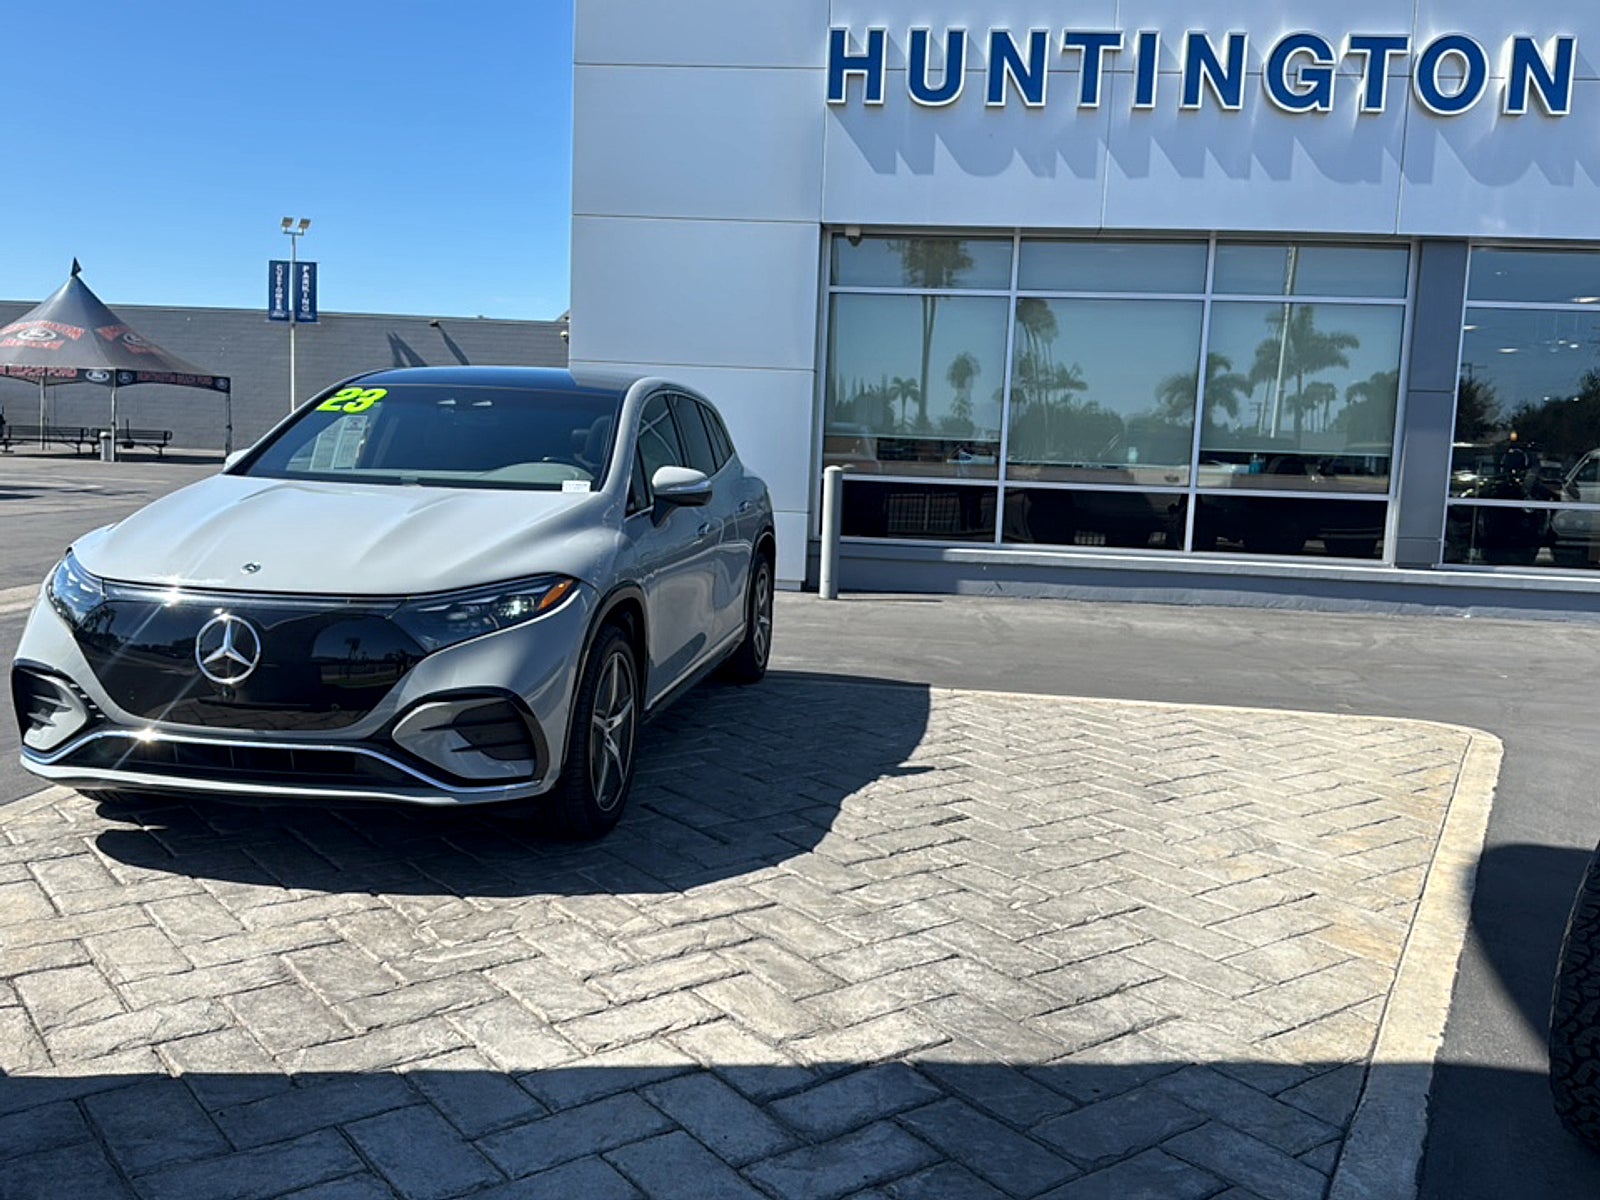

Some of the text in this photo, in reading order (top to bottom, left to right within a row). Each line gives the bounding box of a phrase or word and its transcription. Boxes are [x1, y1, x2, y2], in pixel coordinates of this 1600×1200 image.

[827, 27, 1577, 117] HUNTINGTON
[301, 265, 310, 312] PARKING
[315, 387, 388, 414] 23
